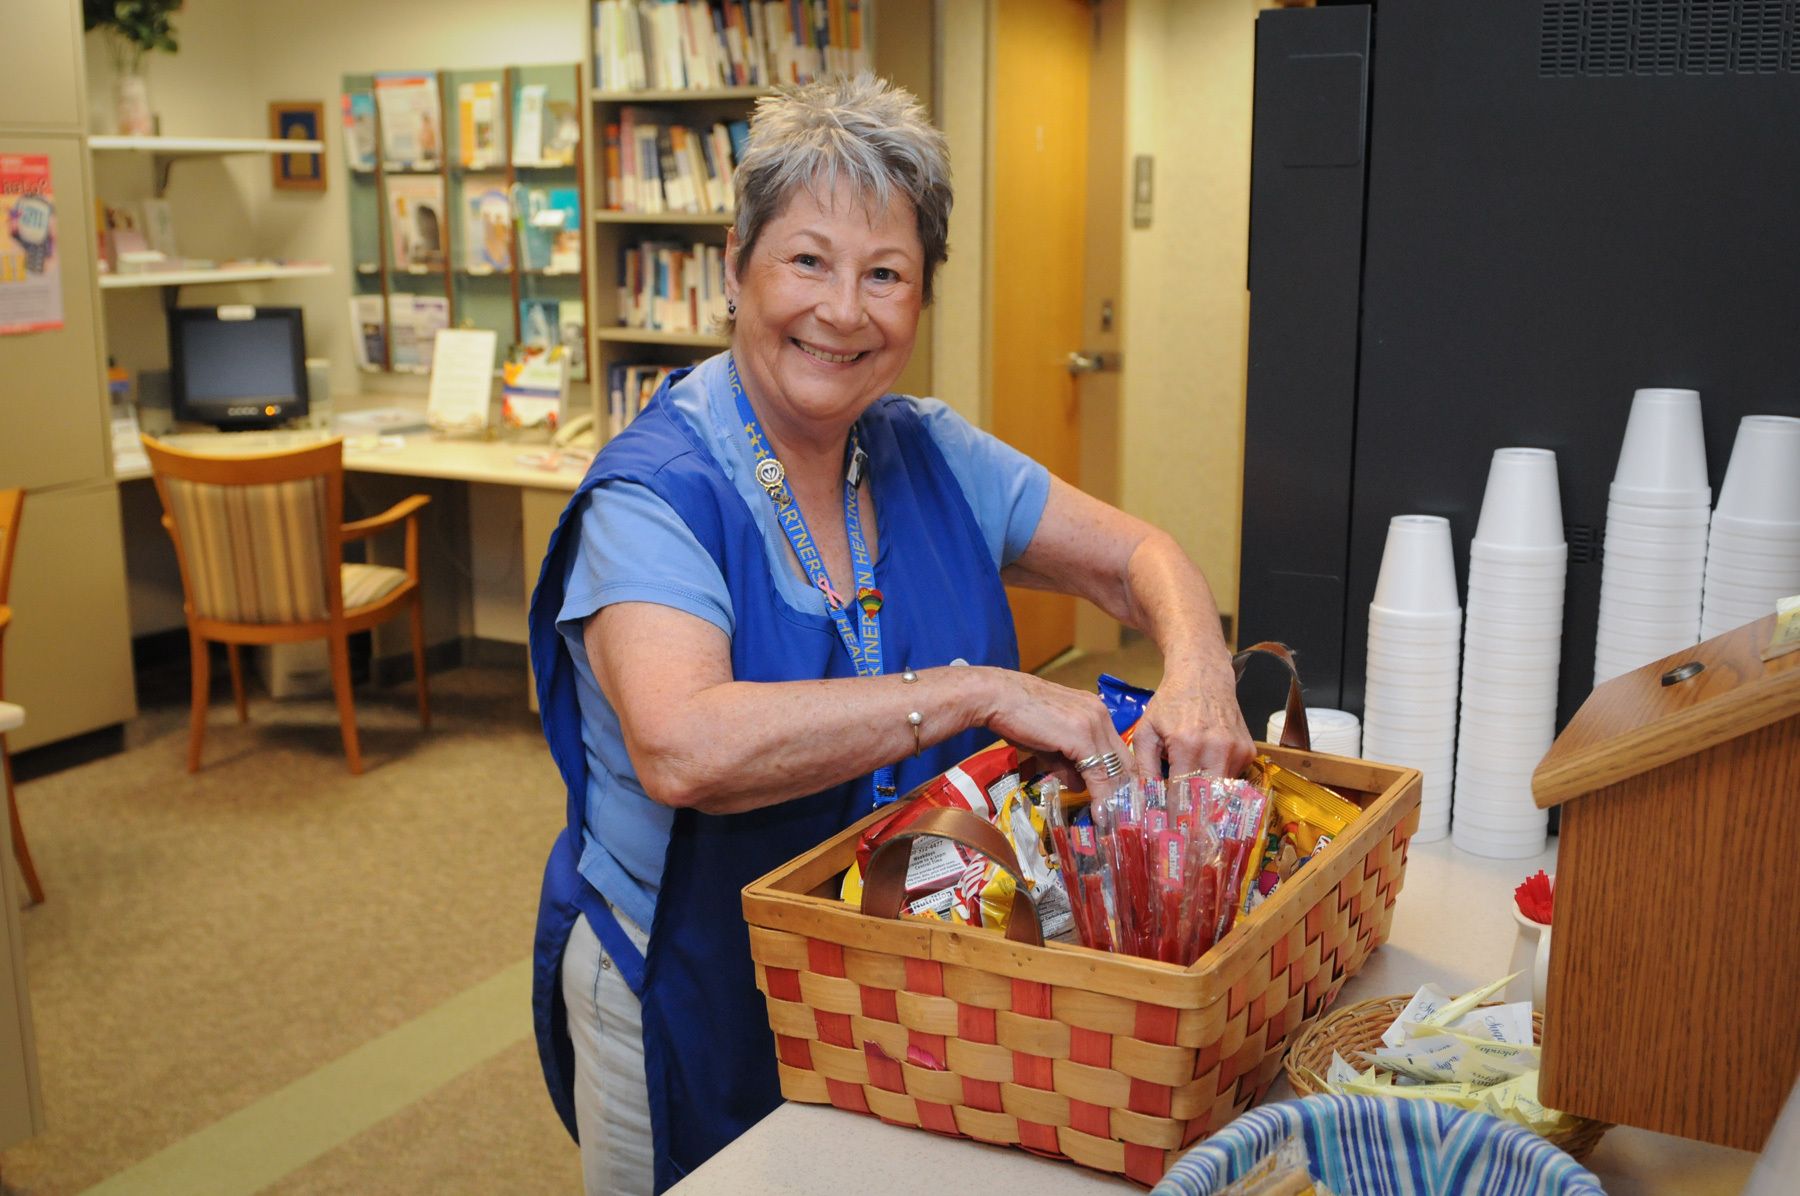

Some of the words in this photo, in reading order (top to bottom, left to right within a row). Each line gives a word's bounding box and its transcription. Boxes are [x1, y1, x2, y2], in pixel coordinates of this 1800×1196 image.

[847, 487, 870, 565] HEALING
[837, 618, 868, 676] HEALI
[914, 861, 932, 871] Central
[913, 890, 952, 909] Nutrition
